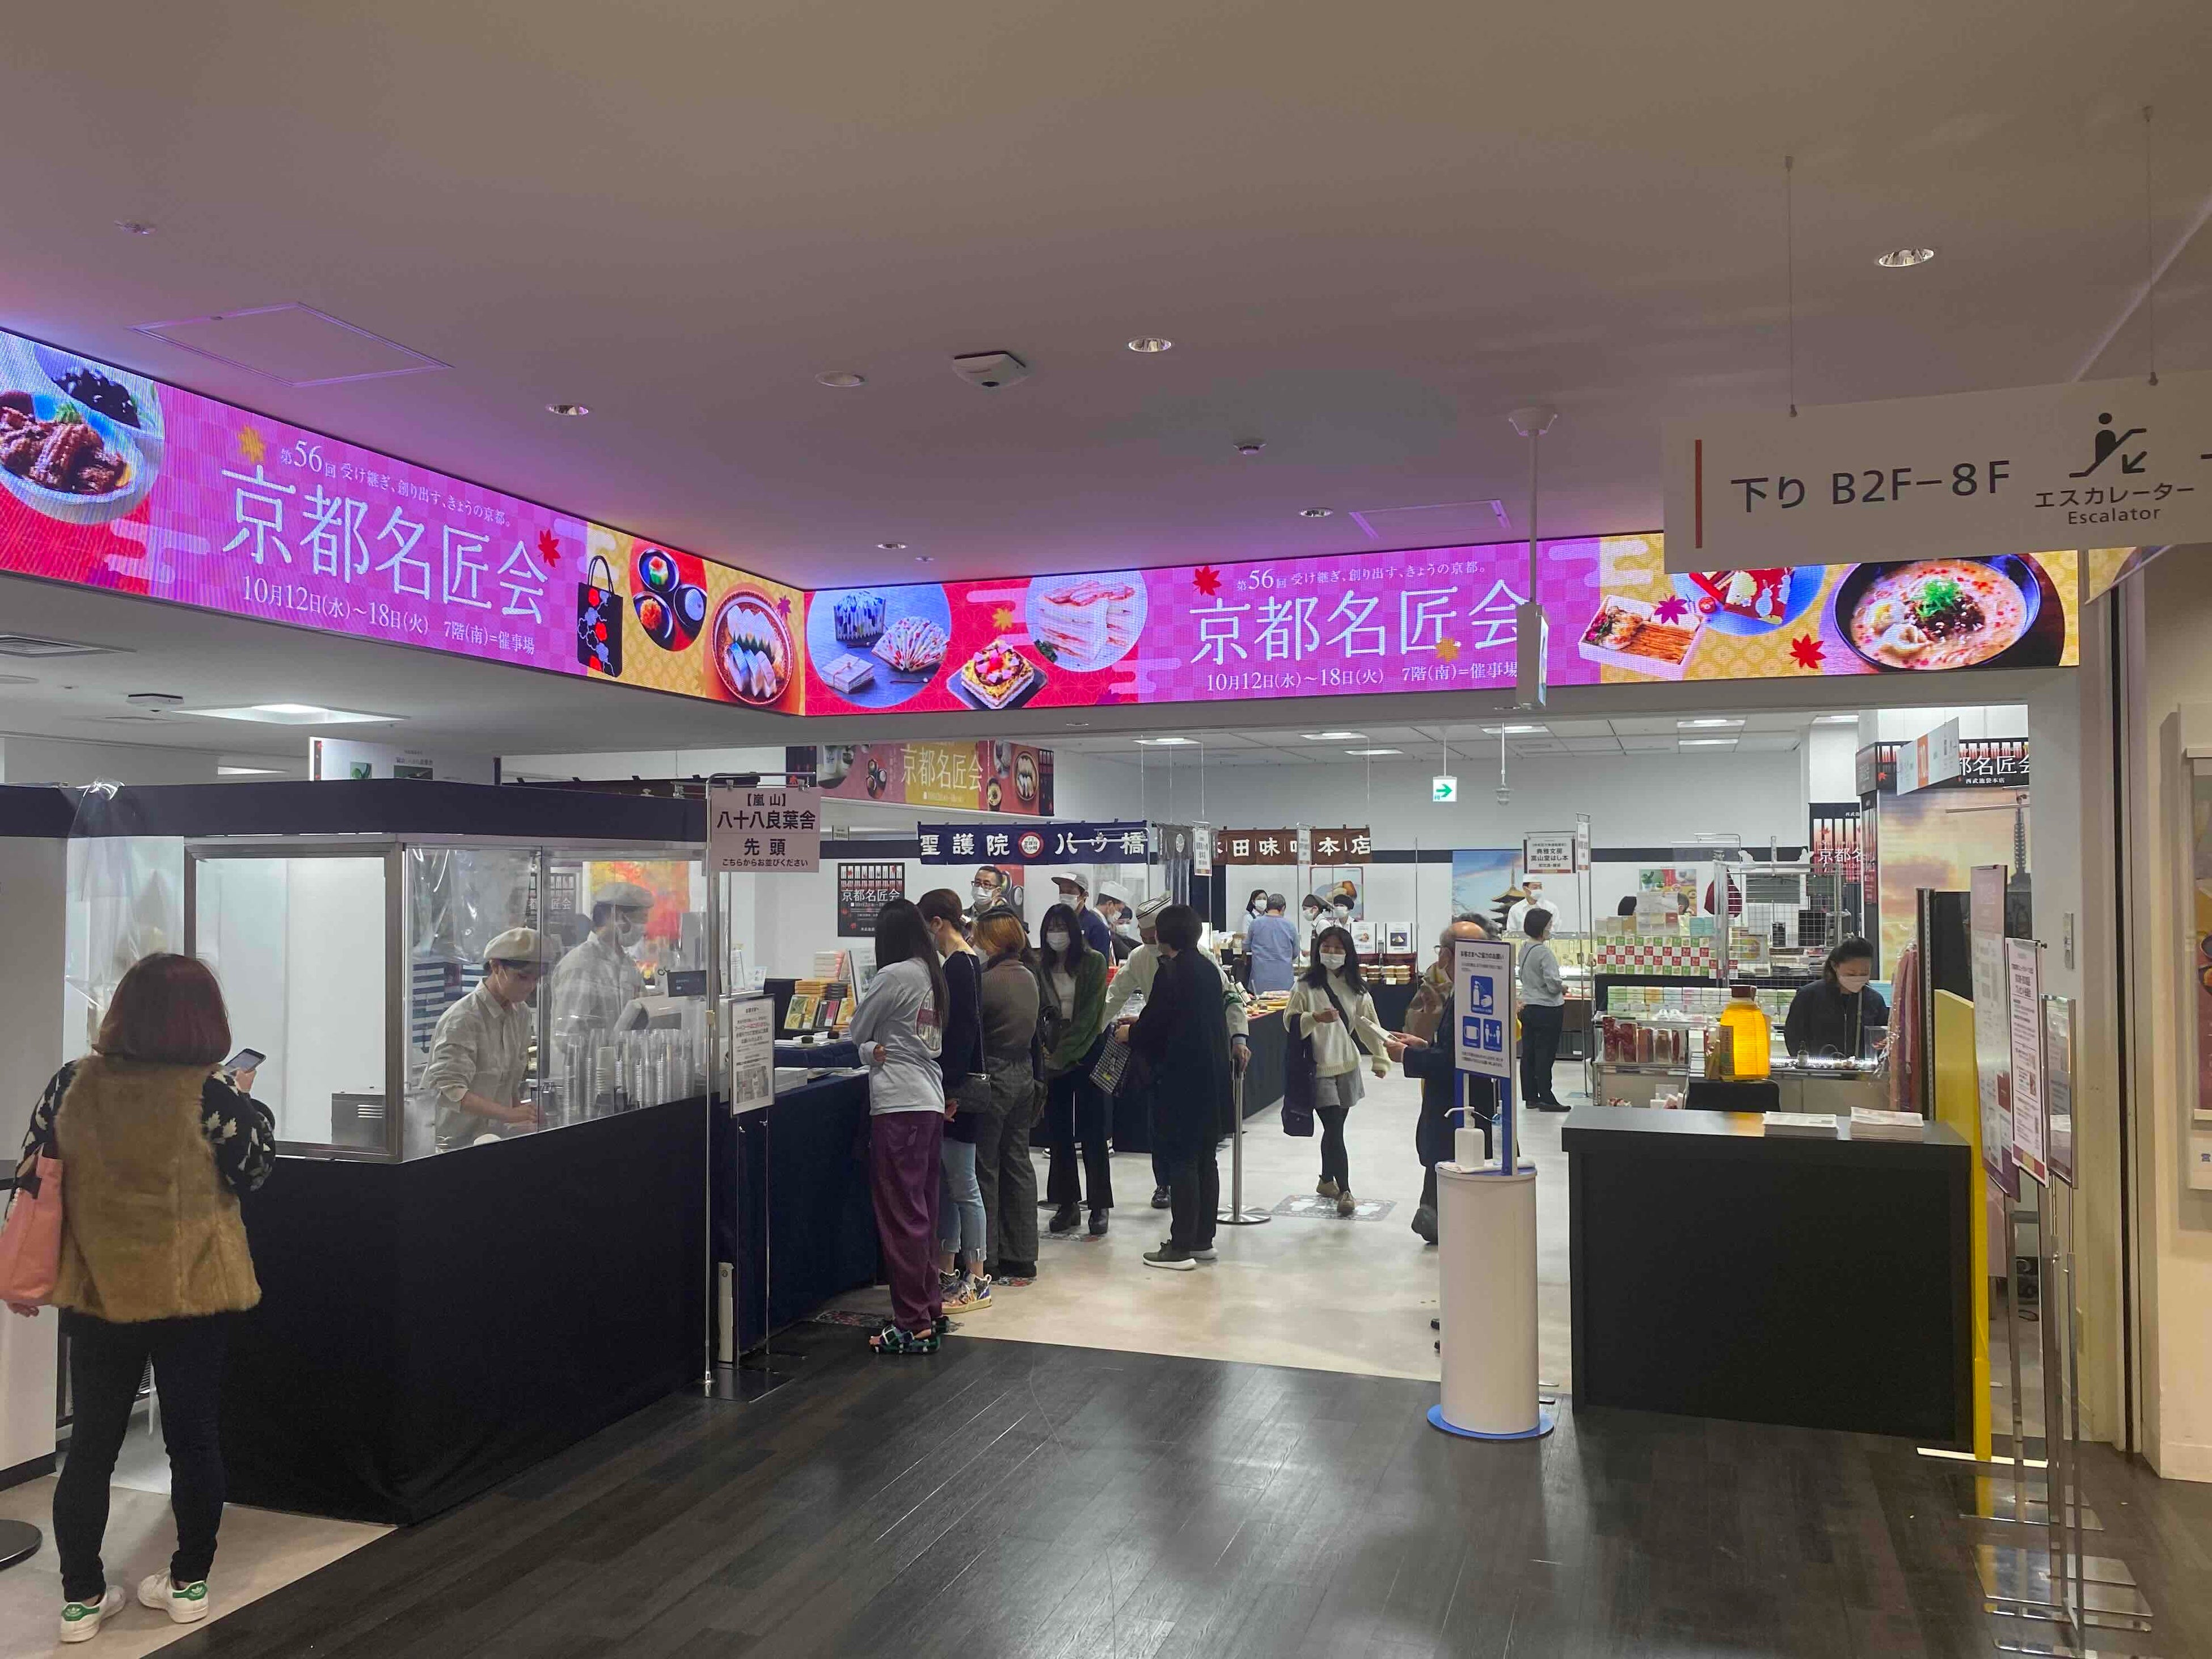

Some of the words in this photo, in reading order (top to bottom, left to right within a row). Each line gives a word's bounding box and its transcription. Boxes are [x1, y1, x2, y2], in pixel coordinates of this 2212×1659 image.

[1730, 476, 1806, 513] 下り
[2034, 481, 2195, 510] エスカレーター
[2068, 505, 2162, 526] Escalator
[220, 464, 548, 624] 京都名匠会
[1189, 579, 1530, 666] 京都名匠会
[900, 743, 984, 792] 京都名匠会
[744, 838, 786, 856] 先頭
[919, 832, 1011, 857] 聖護院
[722, 858, 808, 867] こちらからお並びください
[841, 888, 901, 902] 京都名匠会
